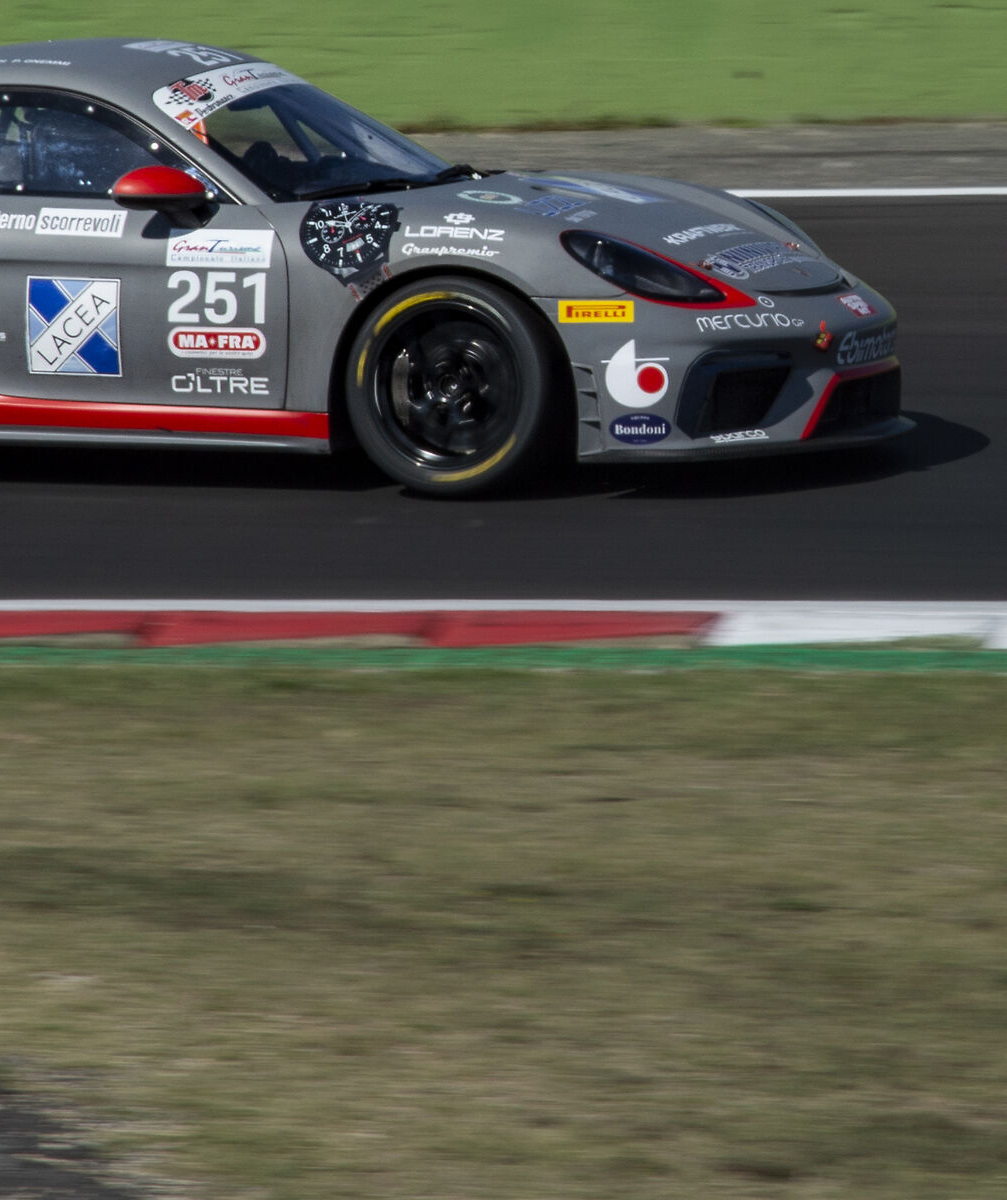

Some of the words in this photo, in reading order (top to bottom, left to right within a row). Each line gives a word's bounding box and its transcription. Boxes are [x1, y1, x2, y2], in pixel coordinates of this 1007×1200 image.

[39, 212, 123, 235] scorrevoli
[404, 225, 506, 241] LORENZ
[167, 269, 267, 324] 251
[566, 305, 627, 318] PIRELLI
[36, 292, 111, 366] LACEA
[614, 423, 666, 436] Bondoni
